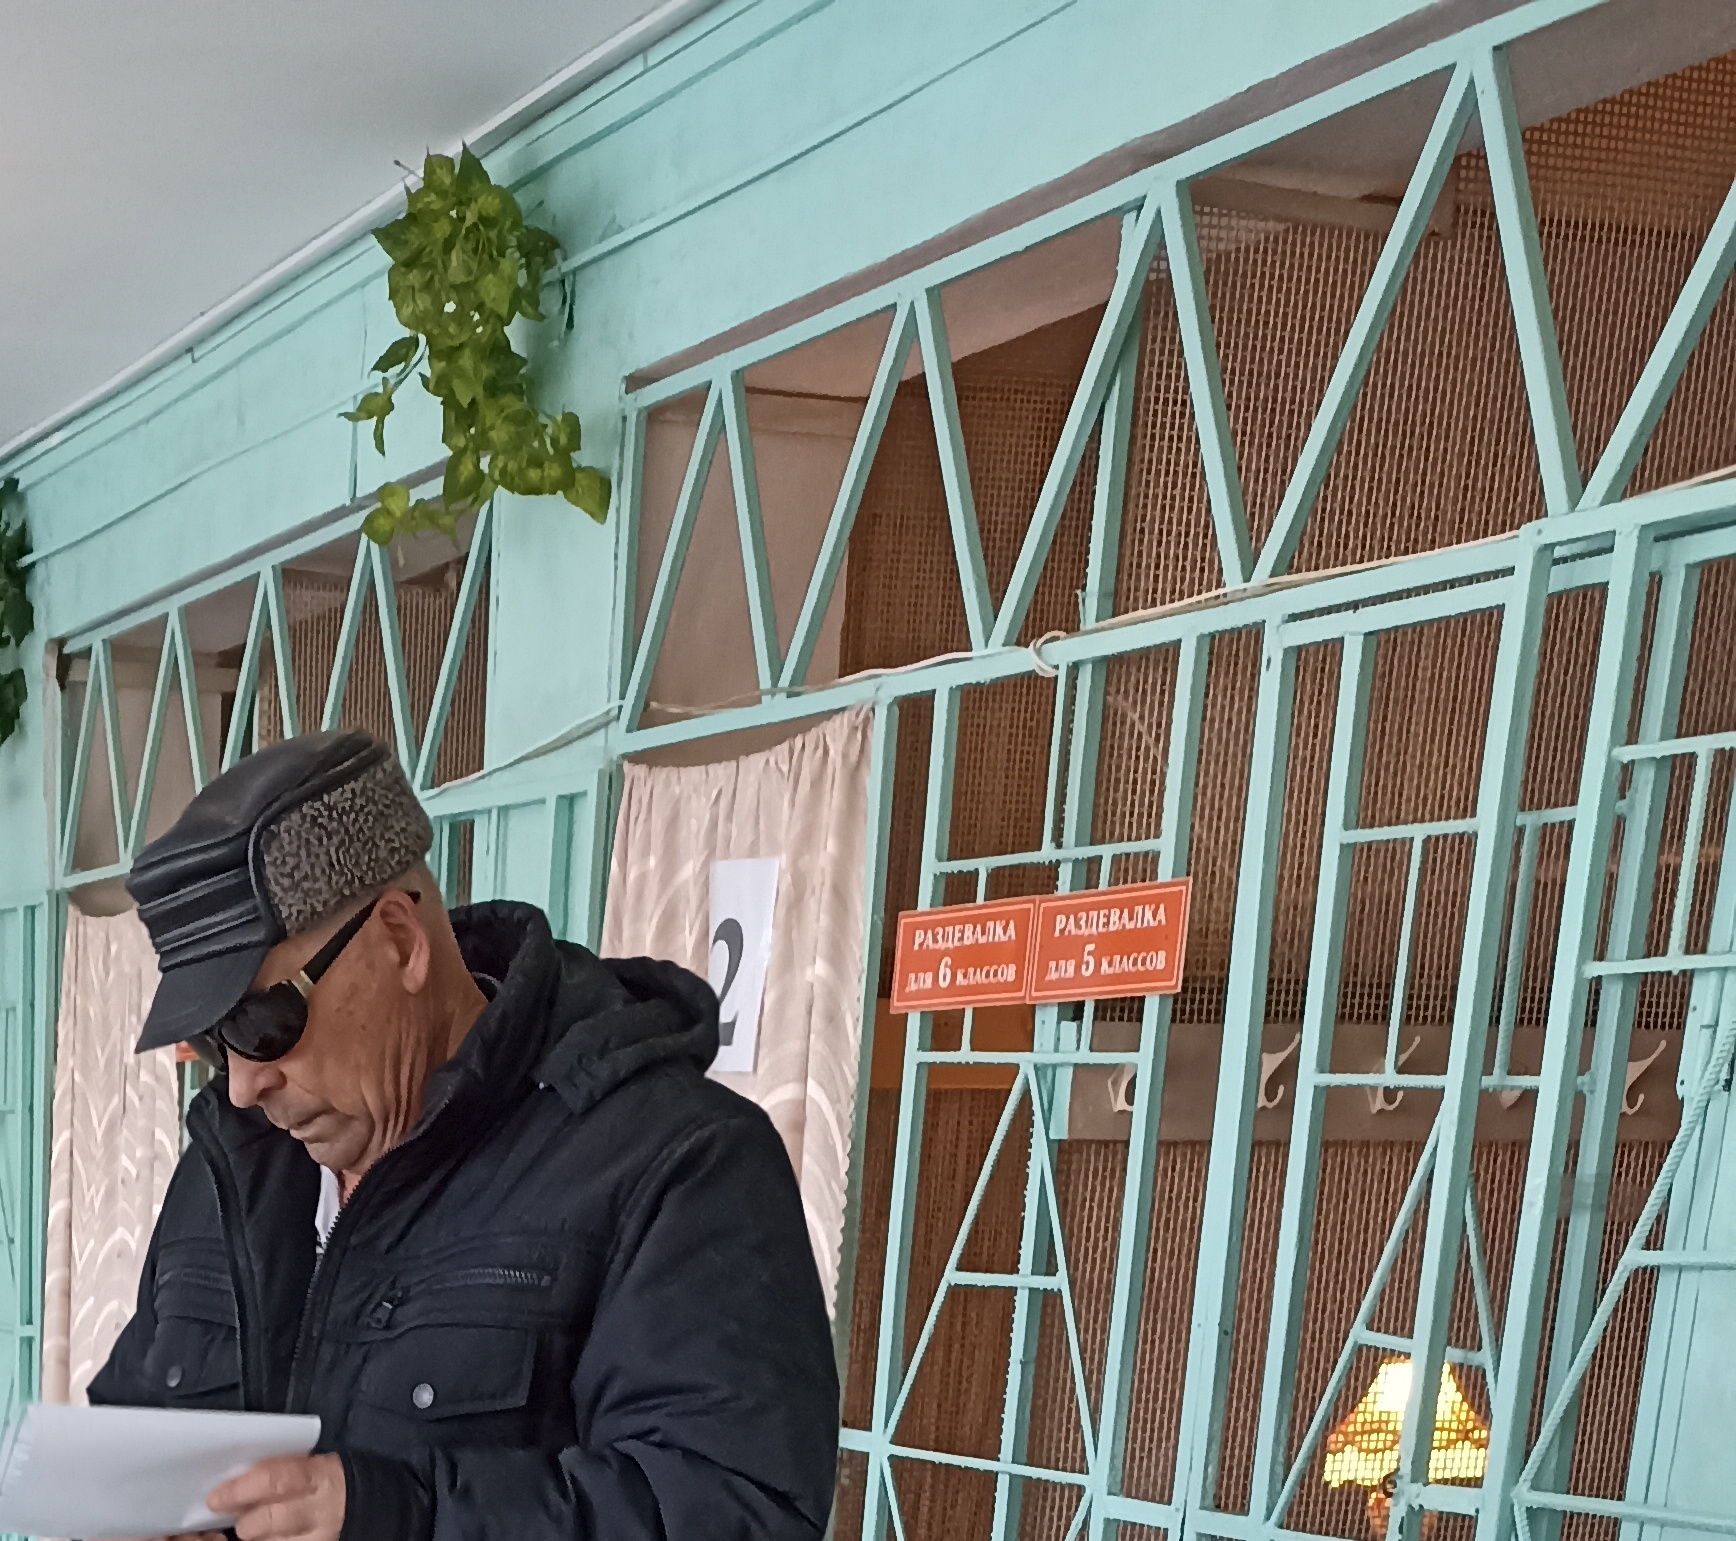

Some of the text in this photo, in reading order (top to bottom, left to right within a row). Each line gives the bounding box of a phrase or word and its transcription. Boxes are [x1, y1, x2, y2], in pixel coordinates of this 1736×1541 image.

[913, 919, 1016, 950] РАЗДЕВАЛКА
[1054, 903, 1166, 937] РАЗДЕВАЛКА
[938, 956, 952, 988] 6
[1081, 943, 1096, 977] 5
